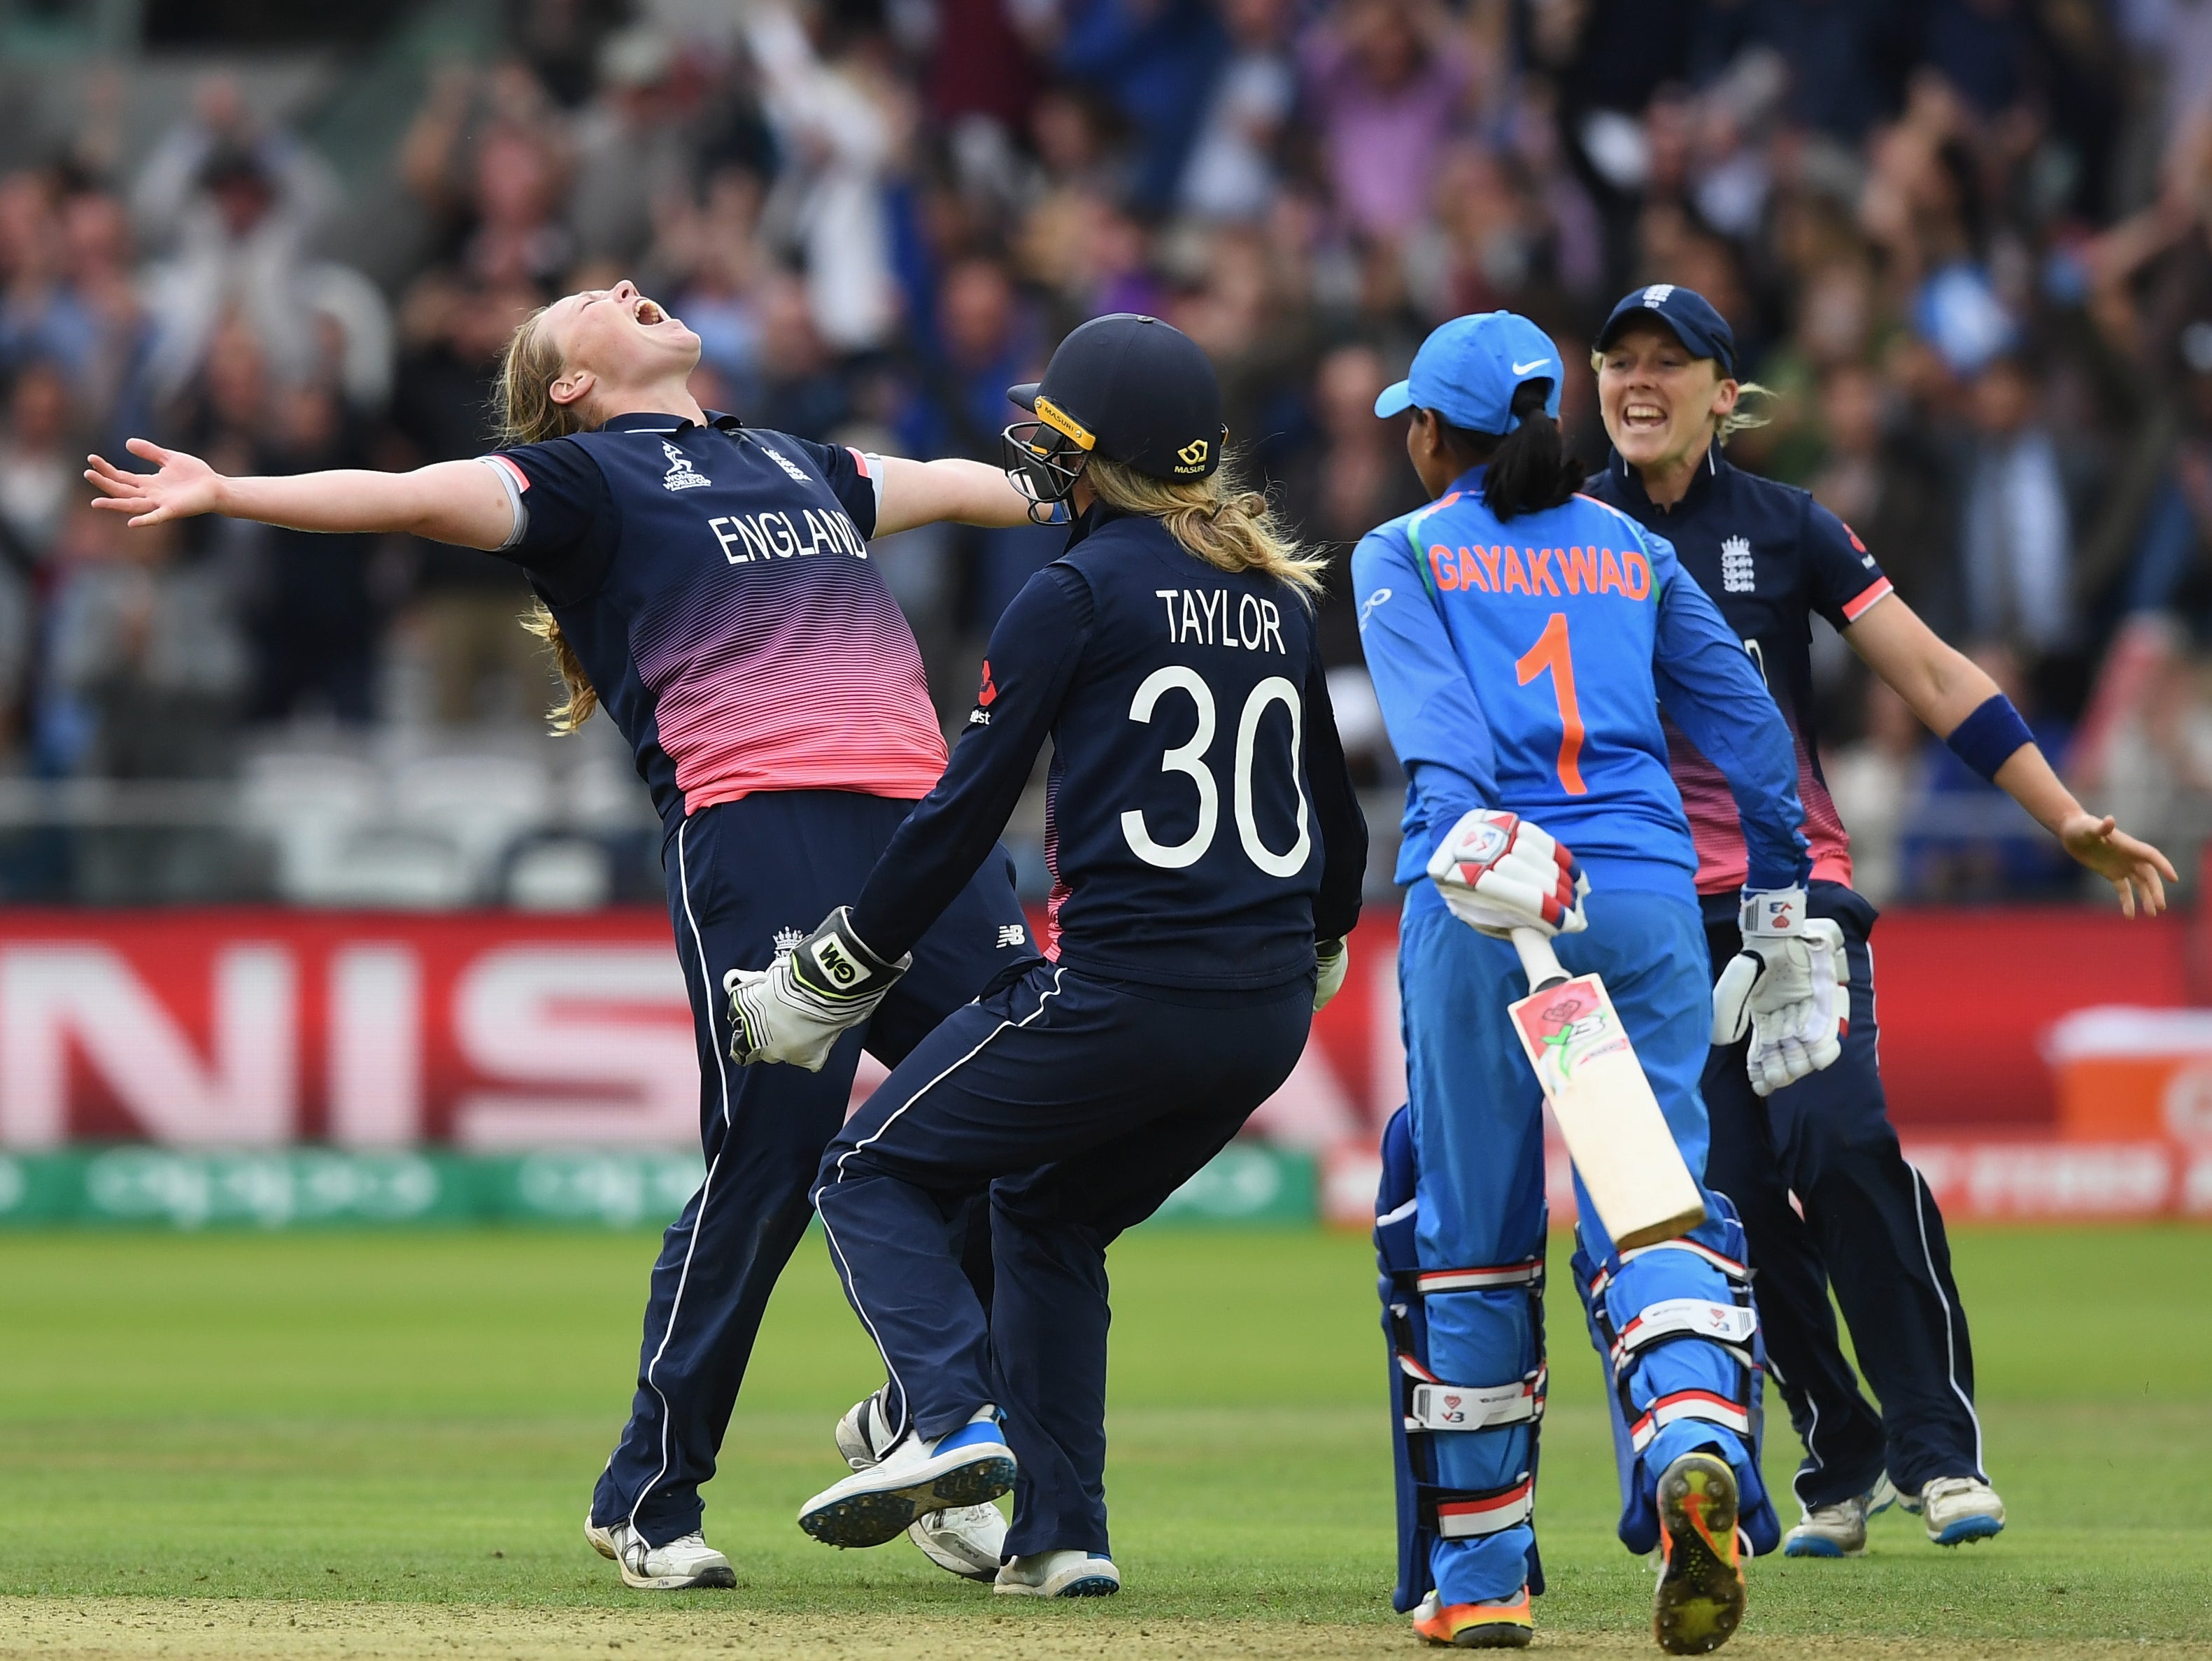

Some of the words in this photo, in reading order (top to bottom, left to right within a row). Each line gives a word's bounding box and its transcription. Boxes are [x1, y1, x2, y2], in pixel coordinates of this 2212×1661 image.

[1044, 407, 1075, 432] MASURI
[708, 508, 868, 565] ENGLAND
[1428, 544, 1651, 602] GAYAKWAD
[1155, 589, 1286, 655] TAYLOR
[1515, 612, 1588, 796] 1
[1121, 665, 1311, 877] 30
